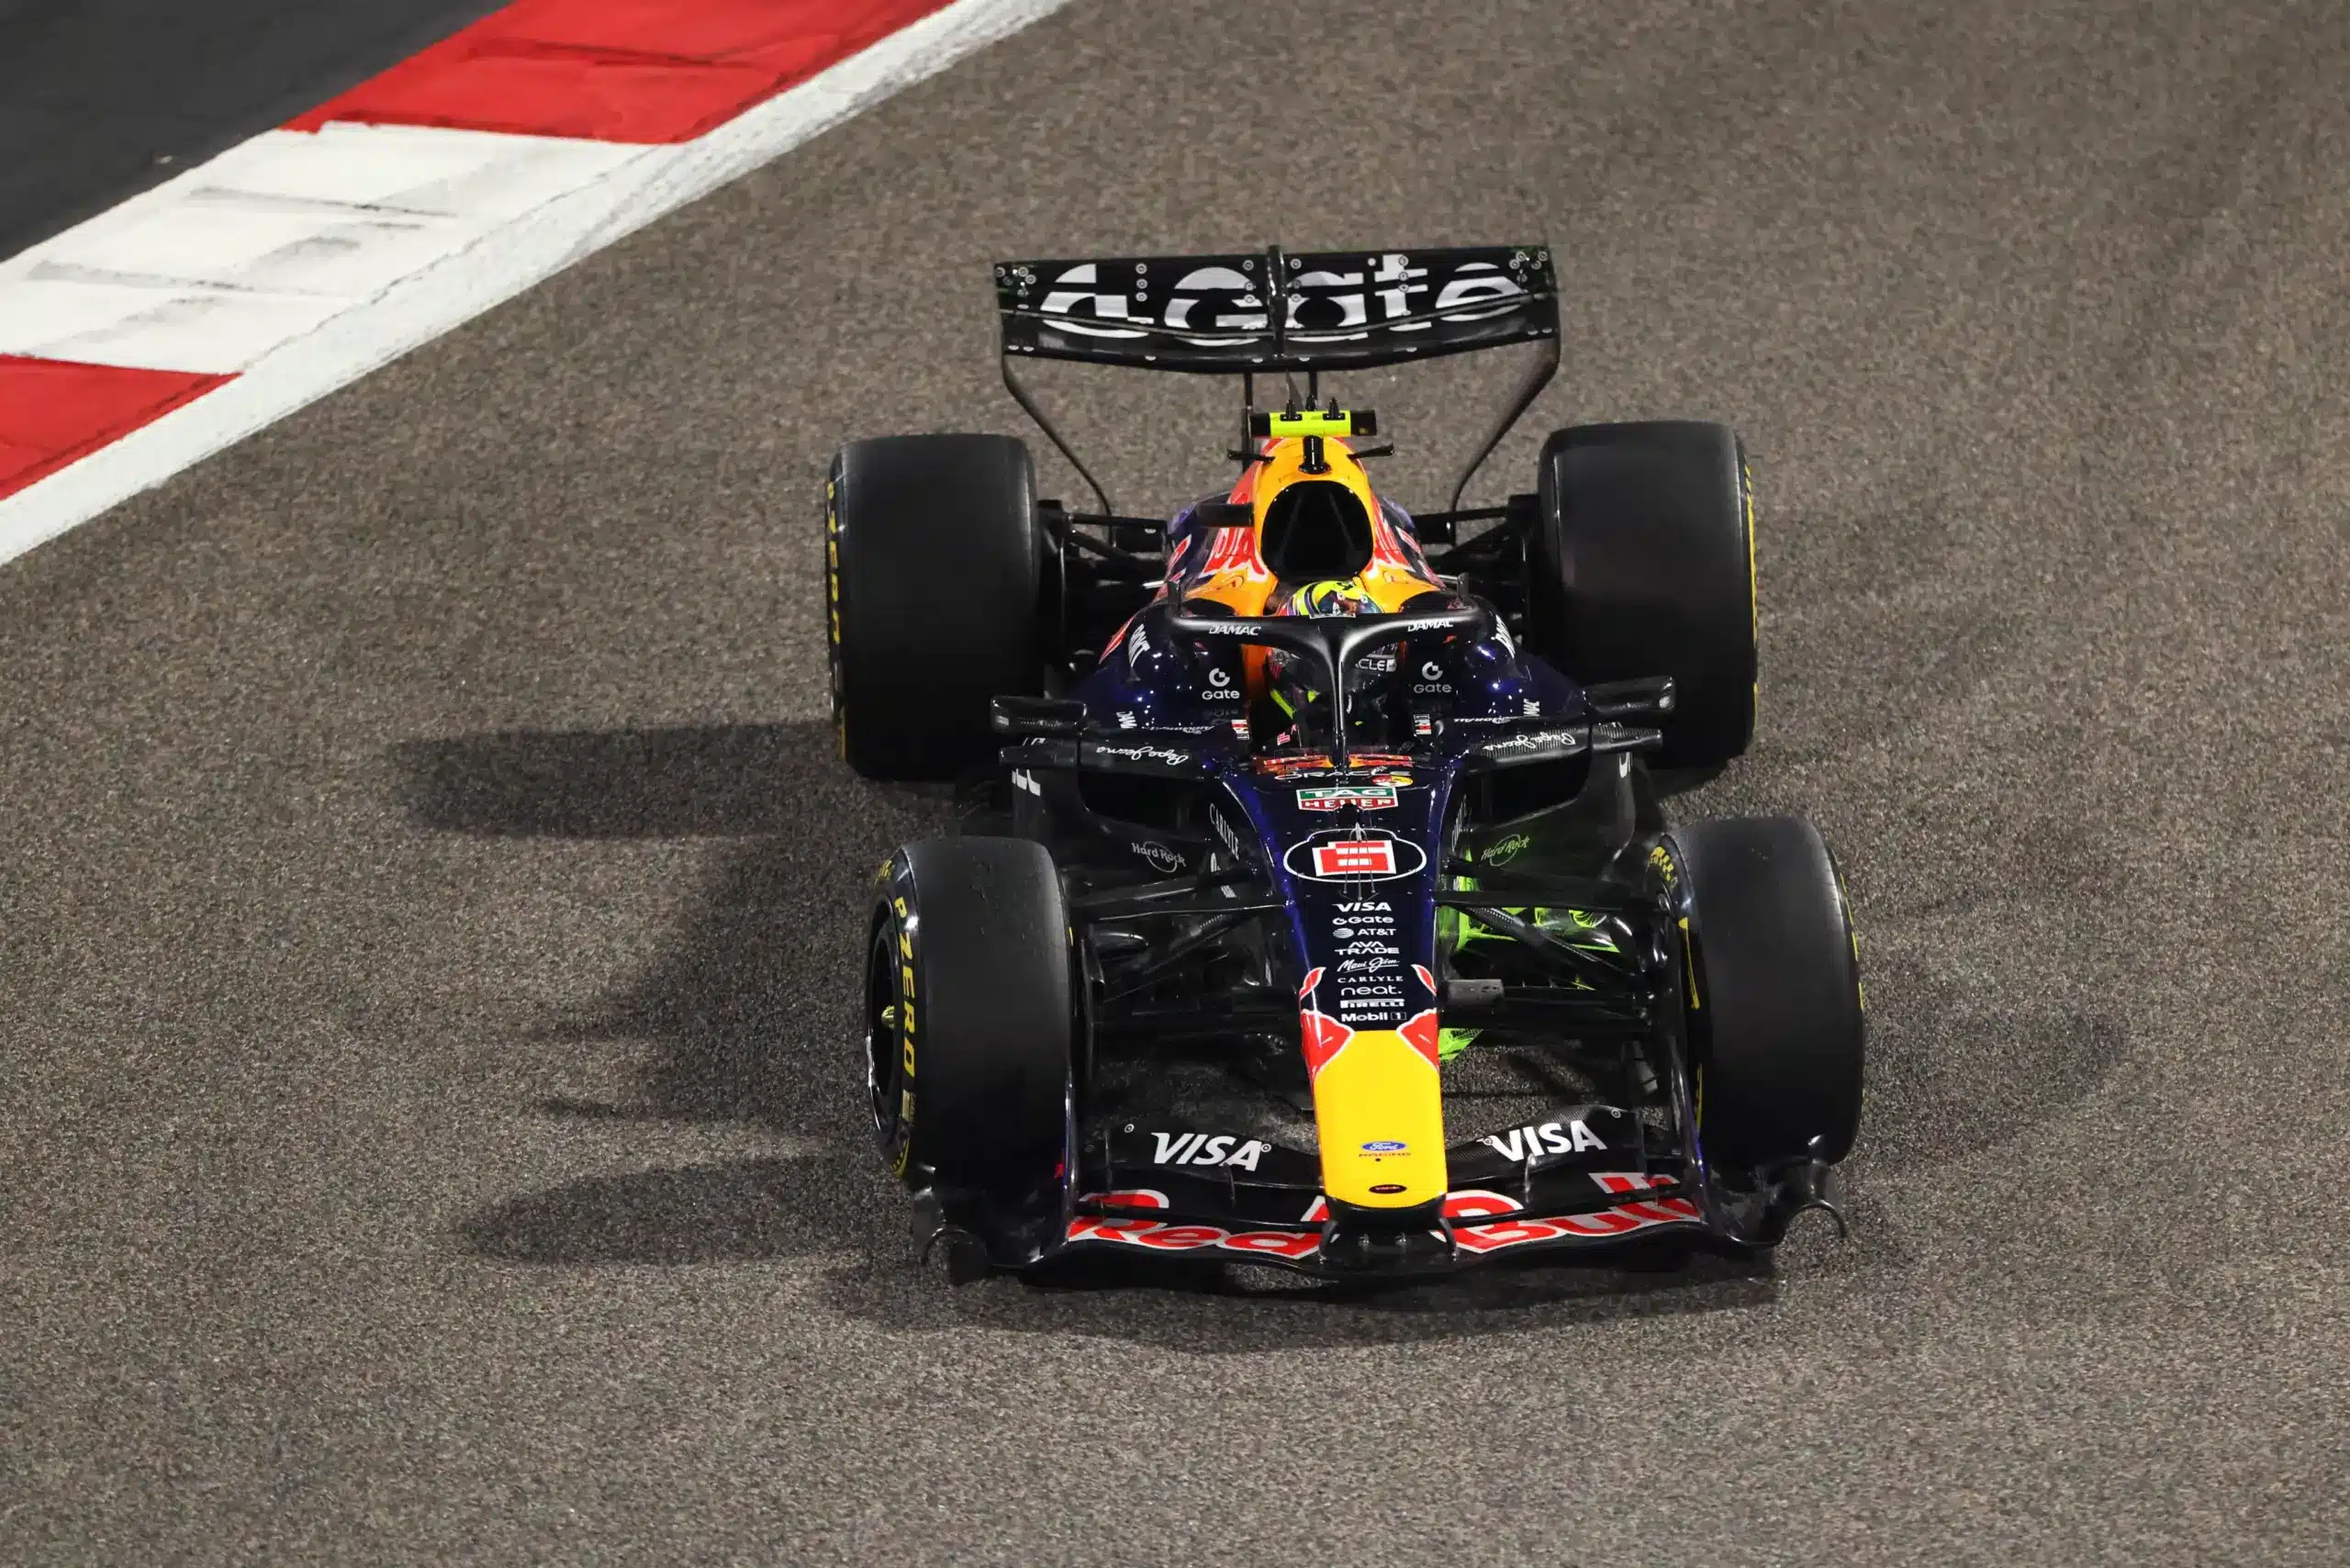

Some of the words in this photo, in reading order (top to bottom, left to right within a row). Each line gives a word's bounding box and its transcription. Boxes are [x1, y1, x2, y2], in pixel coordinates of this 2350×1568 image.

[1208, 624, 1262, 636] DAMAC
[1413, 683, 1452, 694] Gate
[1202, 689, 1240, 700] Gate
[1304, 789, 1388, 797] TAG
[1131, 842, 1159, 858] Hard
[1159, 847, 1187, 868] Rock
[894, 896, 908, 919] P
[1332, 902, 1393, 913] VISA
[1348, 916, 1394, 924] Gate
[1357, 928, 1397, 936] AT&T
[900, 932, 916, 1079] ZERO
[1339, 999, 1405, 1009] PIRELLI
[1341, 1012, 1388, 1022] Mobil
[1476, 1120, 1607, 1162] VISA
[1150, 1132, 1264, 1171] VISA
